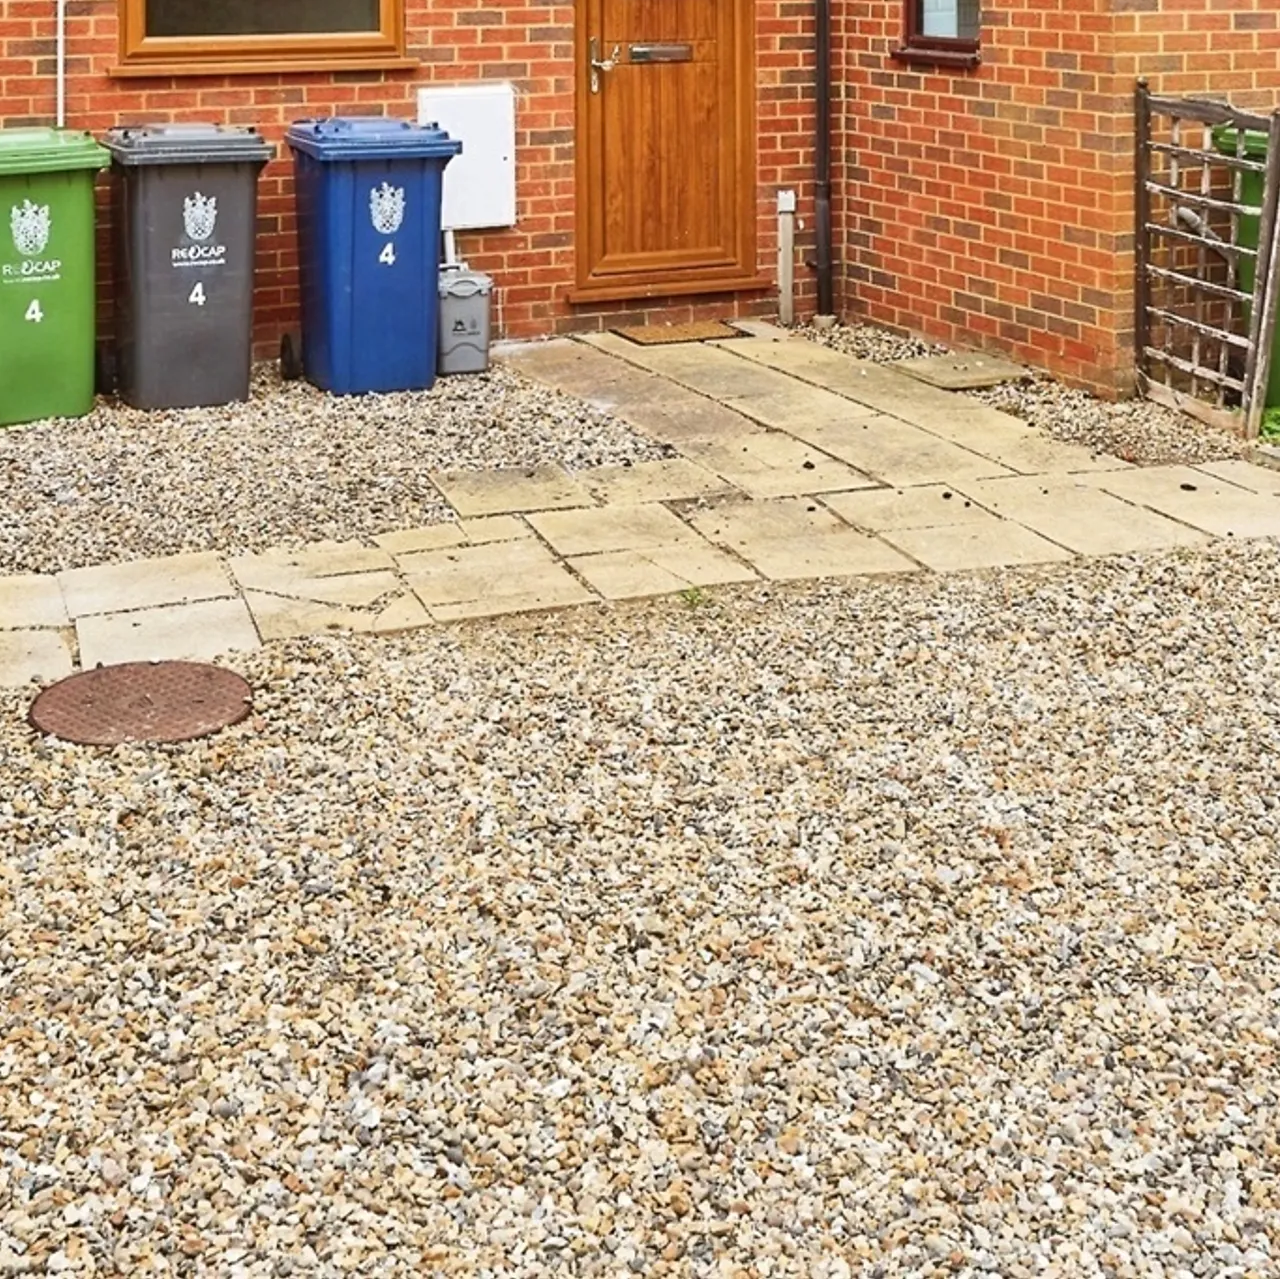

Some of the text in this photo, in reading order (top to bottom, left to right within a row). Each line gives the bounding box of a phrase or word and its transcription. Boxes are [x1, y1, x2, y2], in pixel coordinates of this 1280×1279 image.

[379, 242, 396, 265] 4
[188, 281, 206, 306] 4
[24, 299, 44, 323] 4
